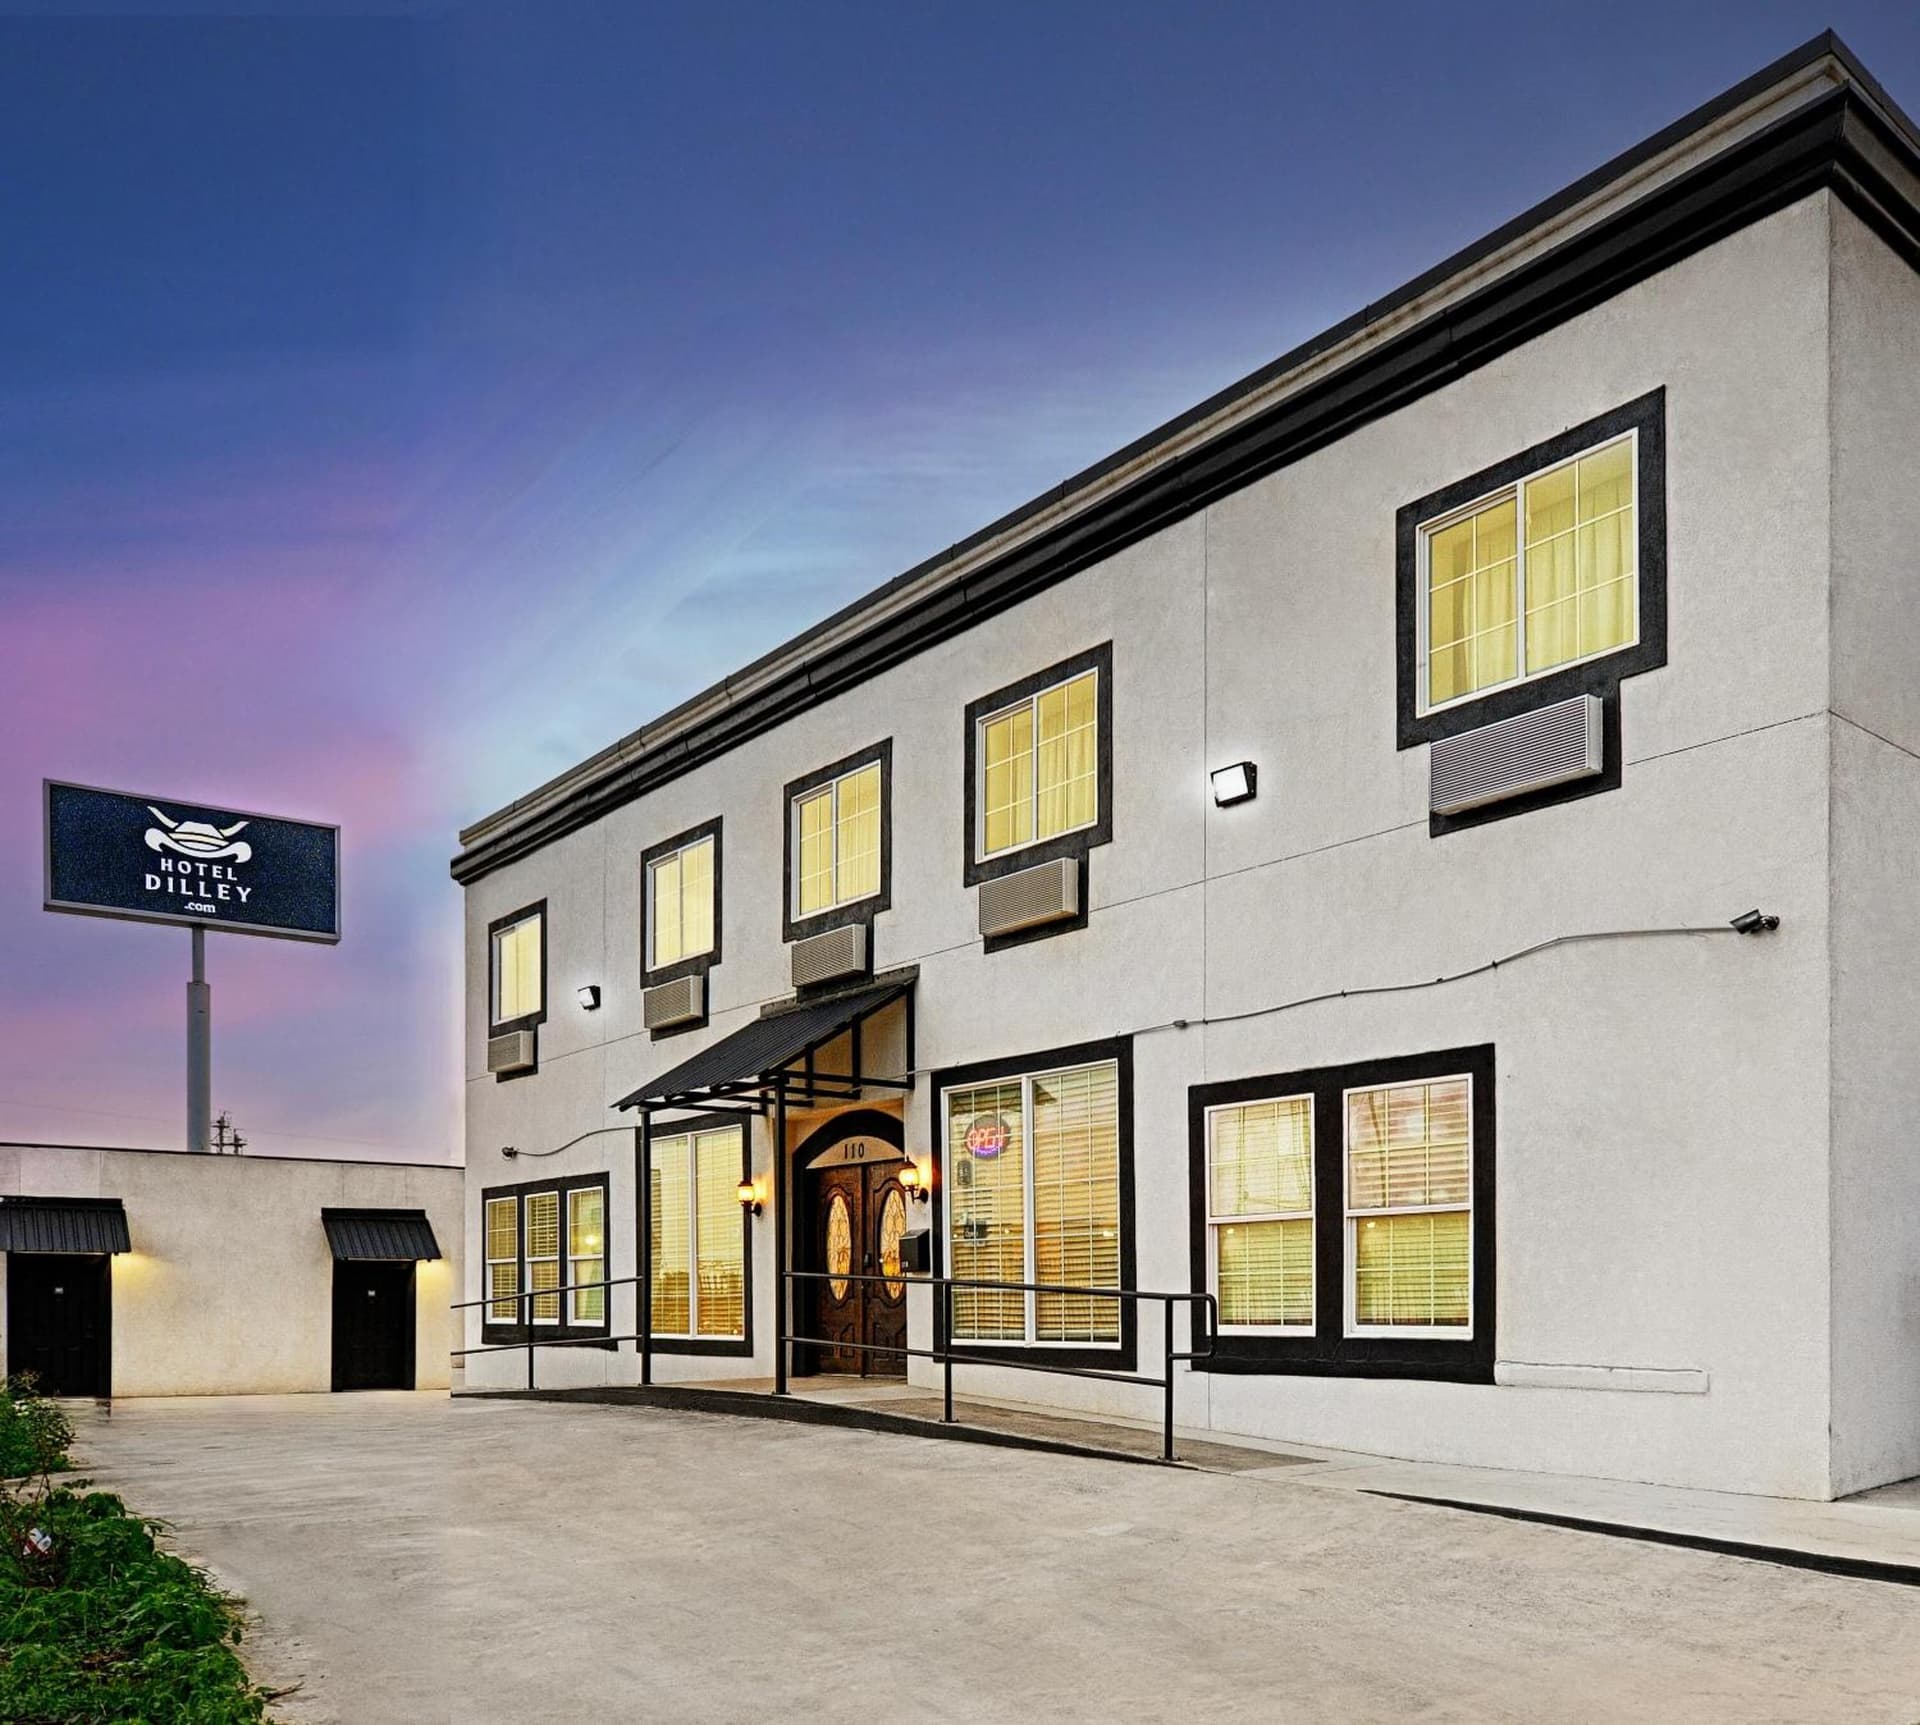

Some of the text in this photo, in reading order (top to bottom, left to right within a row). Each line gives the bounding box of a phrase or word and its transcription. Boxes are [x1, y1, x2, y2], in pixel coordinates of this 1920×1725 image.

[160, 858, 238, 881] HOTEL
[145, 873, 252, 903] DILLEY
[183, 901, 216, 913] .com
[844, 1142, 865, 1159] 110
